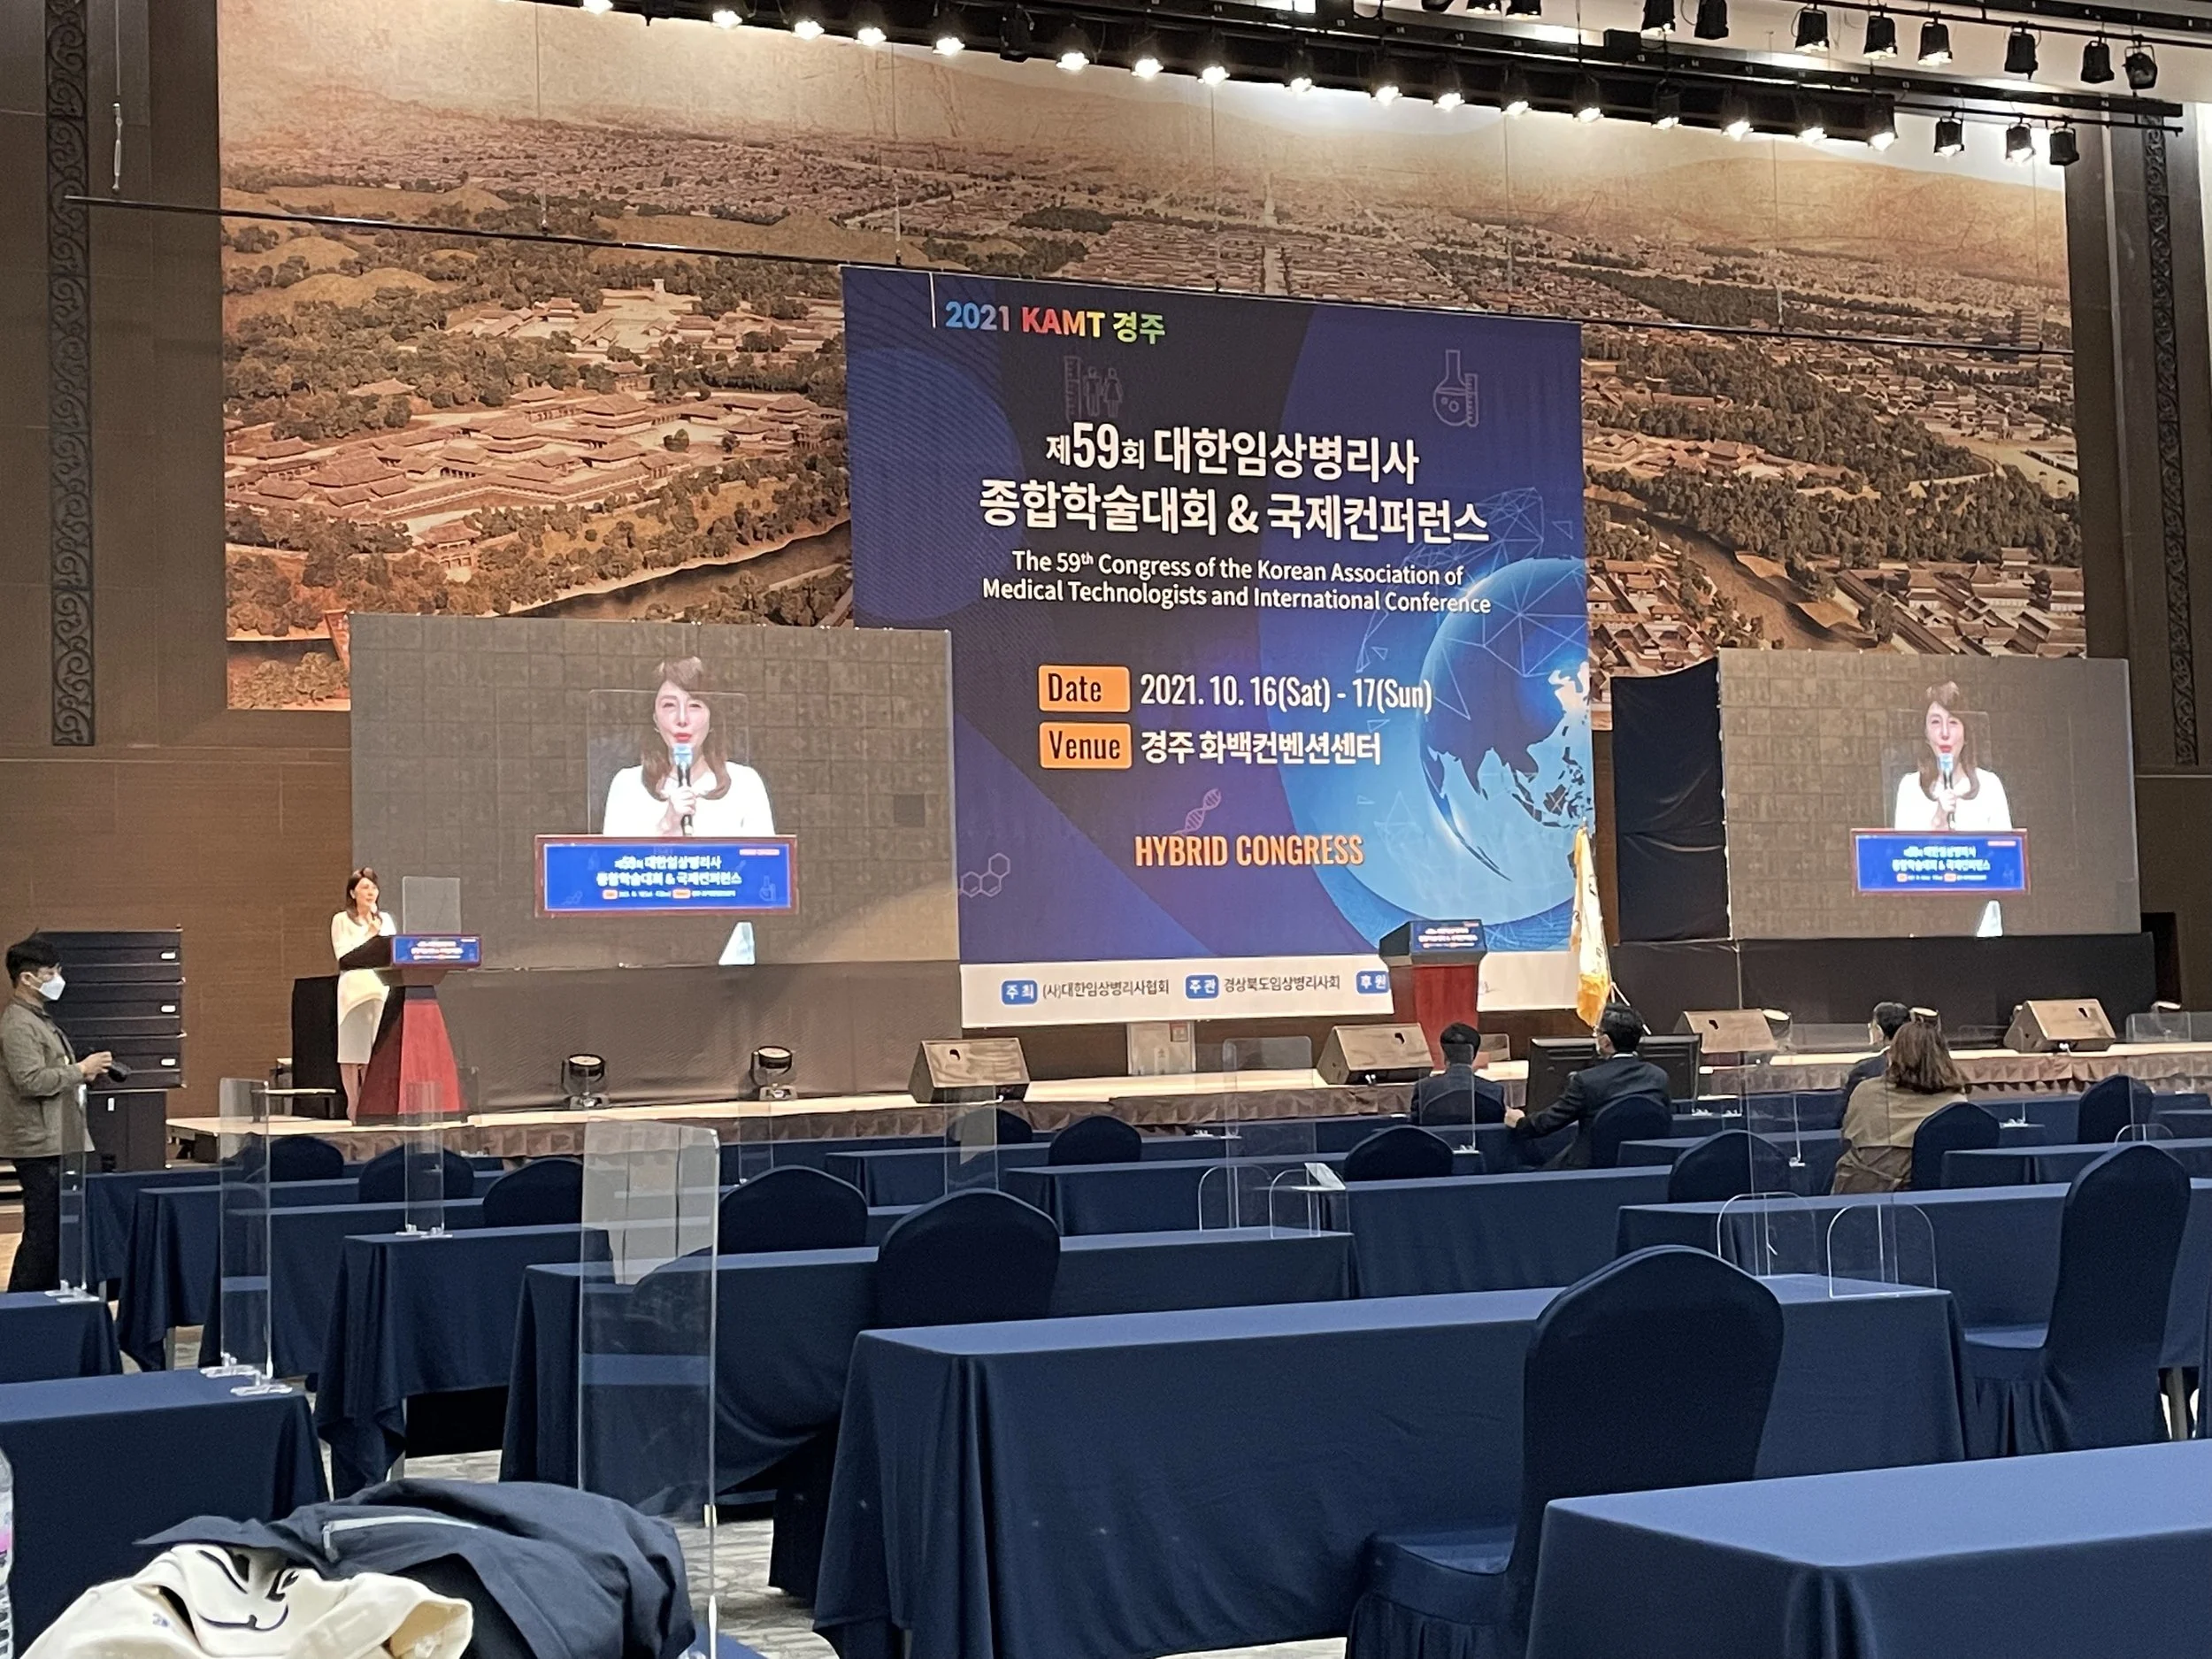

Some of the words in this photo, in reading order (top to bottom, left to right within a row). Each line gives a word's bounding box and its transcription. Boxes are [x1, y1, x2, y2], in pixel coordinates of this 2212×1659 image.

[945, 301, 1010, 332] 2021
[1022, 306, 1105, 337] KAMT
[1113, 311, 1165, 345] 경주
[1046, 422, 1145, 470] 제59회
[1154, 426, 1419, 484] 대한임상병리사
[979, 479, 1217, 535] 종합학술대회
[1227, 497, 1260, 533] &
[1267, 493, 1489, 544] 국제컨퍼런스
[1012, 549, 1052, 572] The
[1056, 552, 1094, 573] 59th
[1098, 554, 1192, 580] Congress
[1194, 557, 1217, 578] of
[1219, 557, 1253, 580] the
[1257, 560, 1326, 581] Korean
[1331, 563, 1440, 585] Association
[1445, 565, 1464, 586] of
[983, 578, 1063, 602] Medical
[1067, 580, 1207, 610] Technologists
[1211, 587, 1248, 607] and
[1254, 588, 1379, 611] International
[1385, 591, 1491, 613] Conference
[1048, 672, 1102, 703] Date
[1141, 674, 1204, 706] 2021.
[1210, 675, 1244, 706] 10.
[1250, 676, 1330, 712] 16(Sat)
[1353, 678, 1432, 714] 17(Sun)
[1048, 730, 1121, 761] Venue
[1141, 731, 1195, 764] 경주
[1199, 730, 1381, 765] 화백컨벤션센터
[1134, 835, 1228, 866] HYBRID
[1236, 834, 1363, 866] CONGRESS
[1224, 975, 1340, 993] 경상북도임상병리사회
